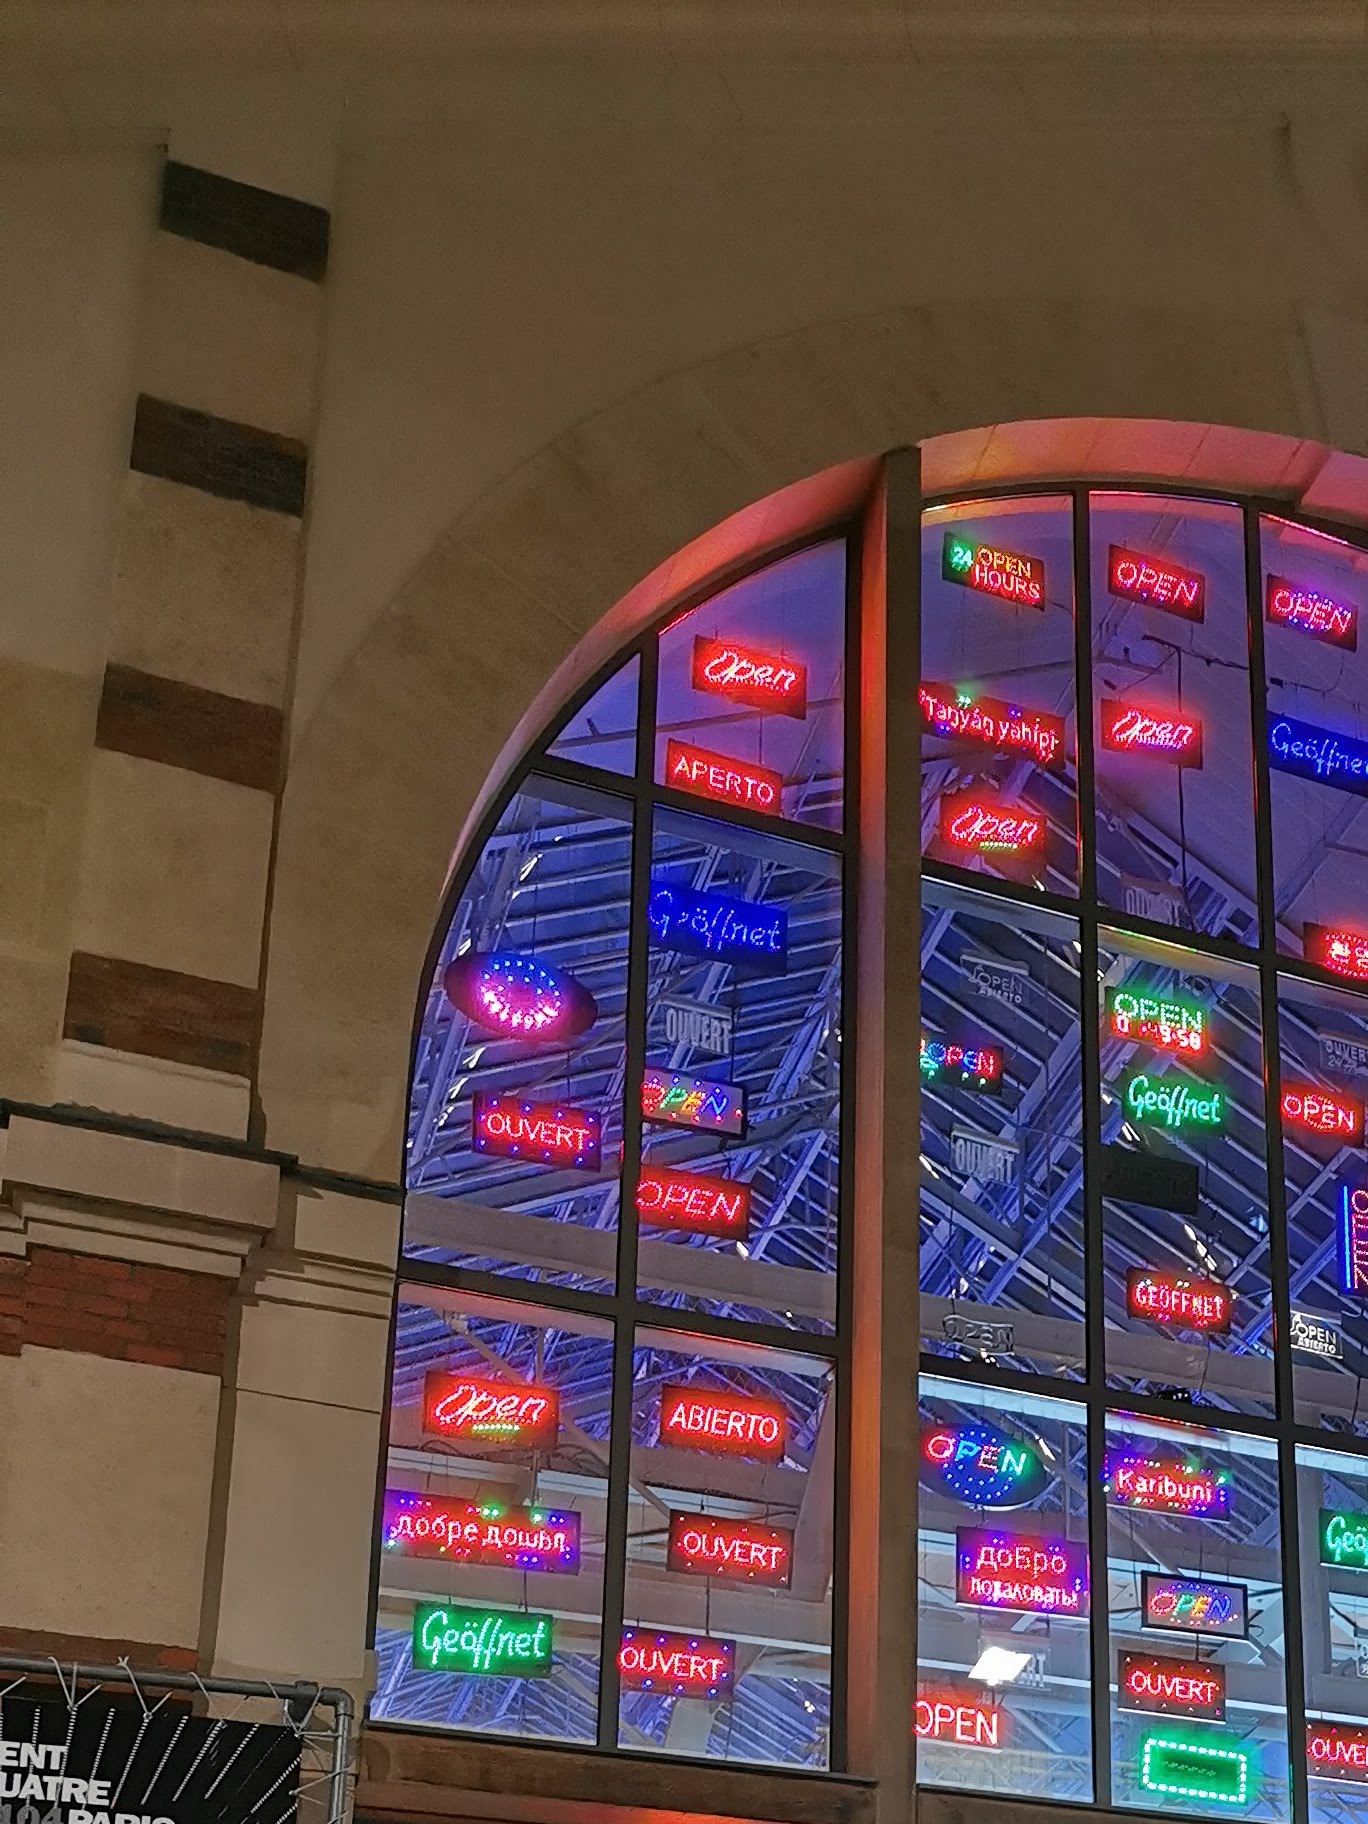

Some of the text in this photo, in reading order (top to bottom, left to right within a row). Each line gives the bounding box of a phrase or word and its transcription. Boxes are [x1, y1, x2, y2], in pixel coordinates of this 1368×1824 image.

[952, 545, 974, 566] 24
[976, 547, 1032, 578] OPEN
[974, 564, 1041, 600] HOURS
[1116, 560, 1198, 606] OPEN
[1274, 588, 1352, 633] OPEN
[704, 648, 797, 692] Open
[1111, 709, 1194, 748] Open
[673, 754, 775, 806] APERTO
[950, 804, 1039, 844] Open
[648, 889, 782, 952] Göffnet
[1114, 992, 1204, 1033] OPEN
[642, 1080, 729, 1117] OPEN
[1127, 1074, 1222, 1127] Geöffnet
[1283, 1092, 1355, 1133] OPEN
[487, 1111, 592, 1153] OUVERT
[635, 1179, 742, 1222] OPEN
[1297, 1320, 1337, 1345] OPEN
[434, 1384, 549, 1428] Open
[668, 1402, 780, 1443] ABIERTO
[927, 1433, 1027, 1476] OPEN
[1117, 1468, 1213, 1503] Karibuni
[682, 1529, 786, 1570] OUVERT
[1150, 1590, 1232, 1625] OPEN
[421, 1610, 546, 1670] Geöffnet
[619, 1646, 727, 1682] OUVERT
[1131, 1670, 1218, 1704] OUVERT
[915, 1699, 998, 1747] OPEN
[0, 1740, 68, 1771] ENT
[0, 1771, 112, 1806] UATRE
